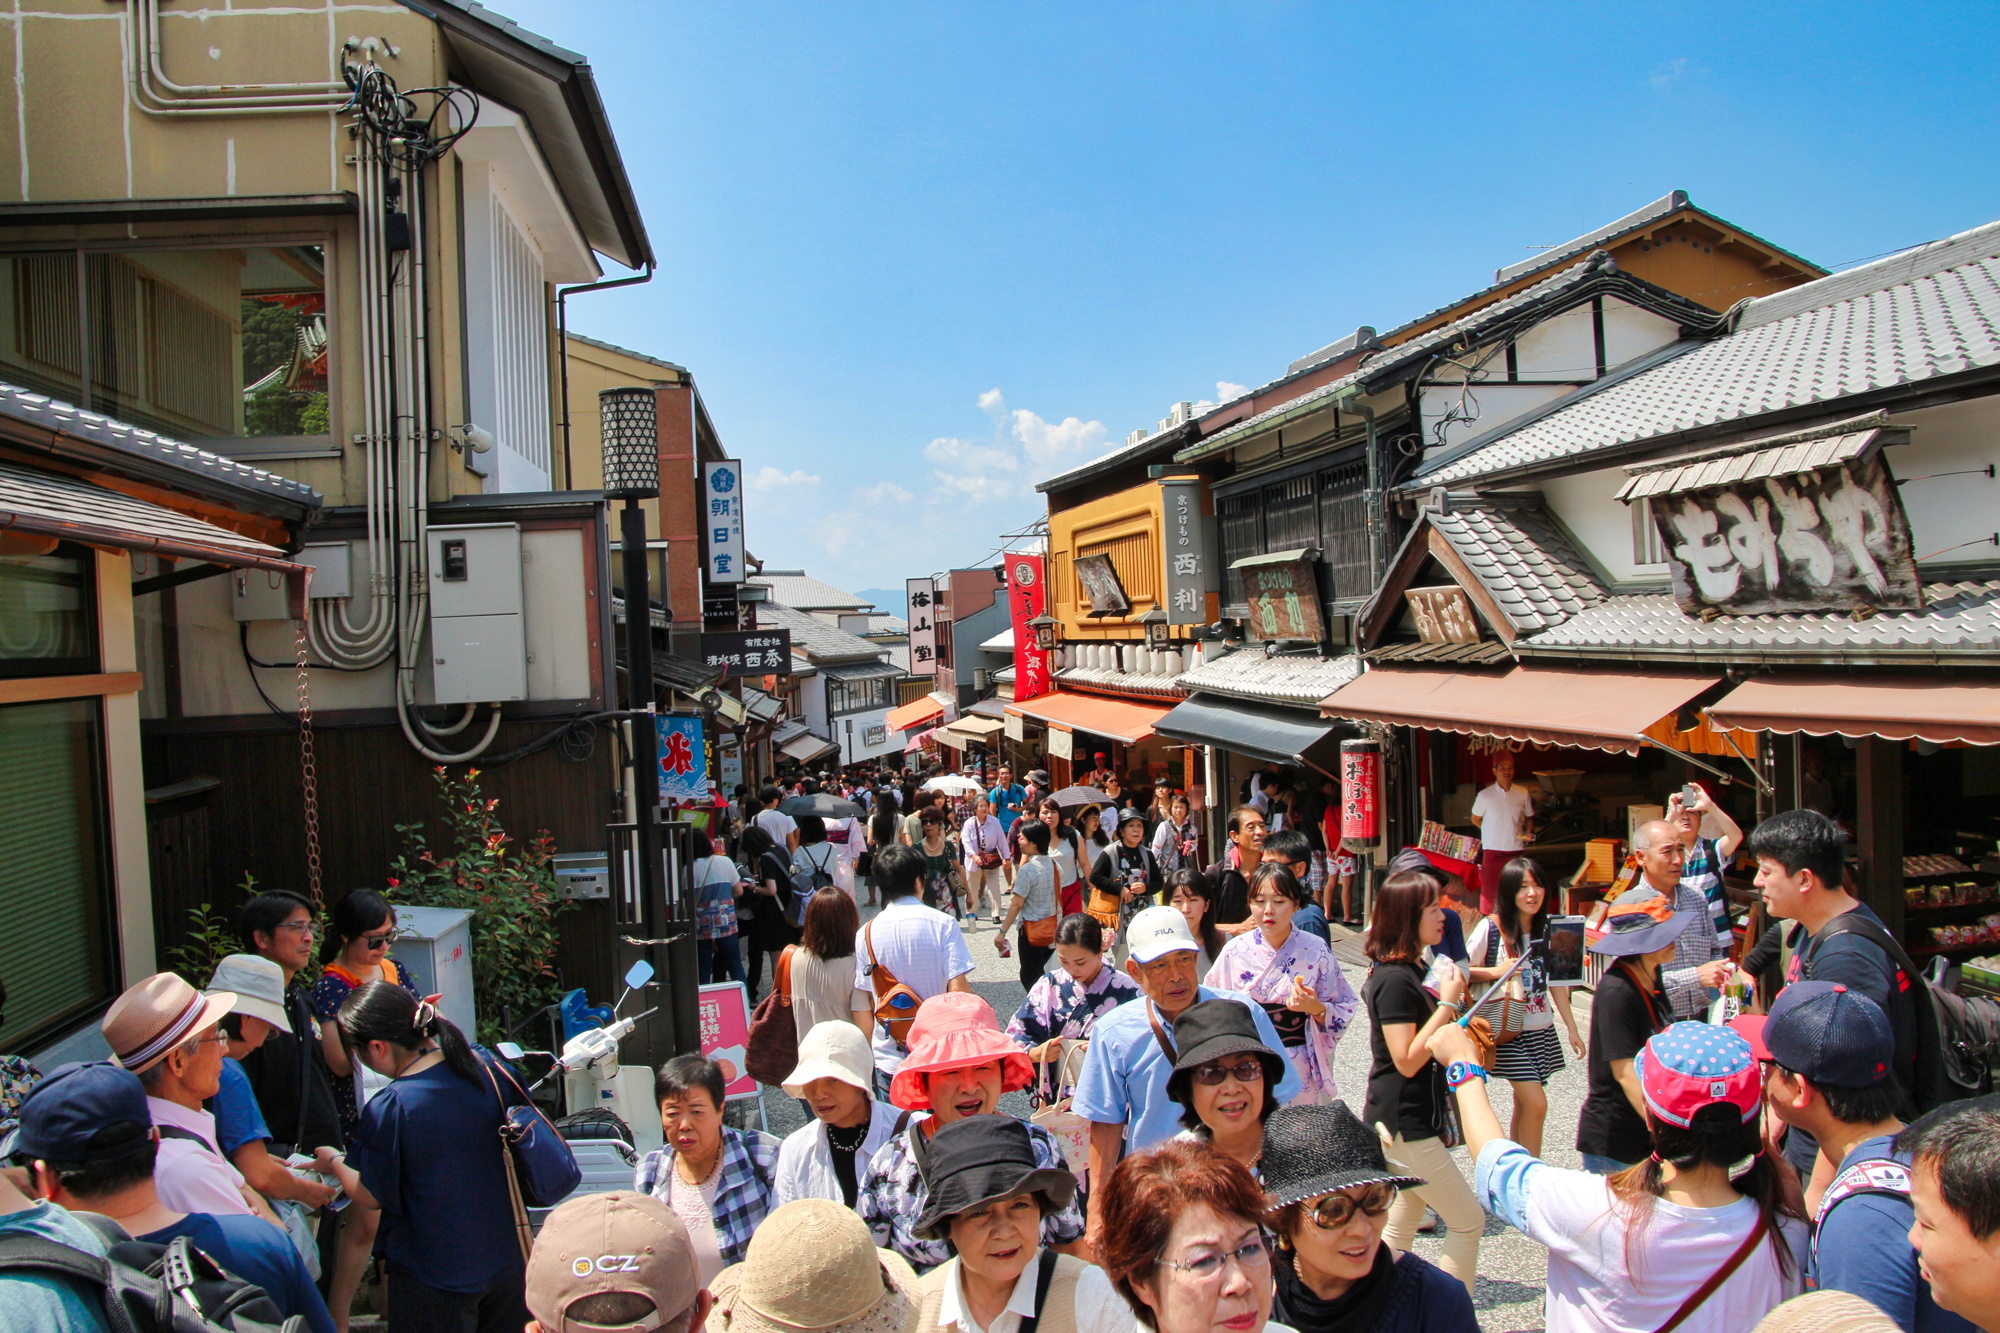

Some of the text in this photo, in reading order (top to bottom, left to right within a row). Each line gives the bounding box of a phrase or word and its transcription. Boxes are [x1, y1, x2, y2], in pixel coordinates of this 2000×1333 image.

[711, 498, 732, 574] 朝日堂
[1177, 494, 1189, 546] 京つけもの
[1173, 552, 1197, 612] 西利
[745, 637, 781, 647] 有限会社
[911, 591, 935, 662] 梅山堂
[707, 648, 783, 668] 清水焼 西秀
[1154, 928, 1174, 937] FILA
[596, 1255, 640, 1273] CZ
